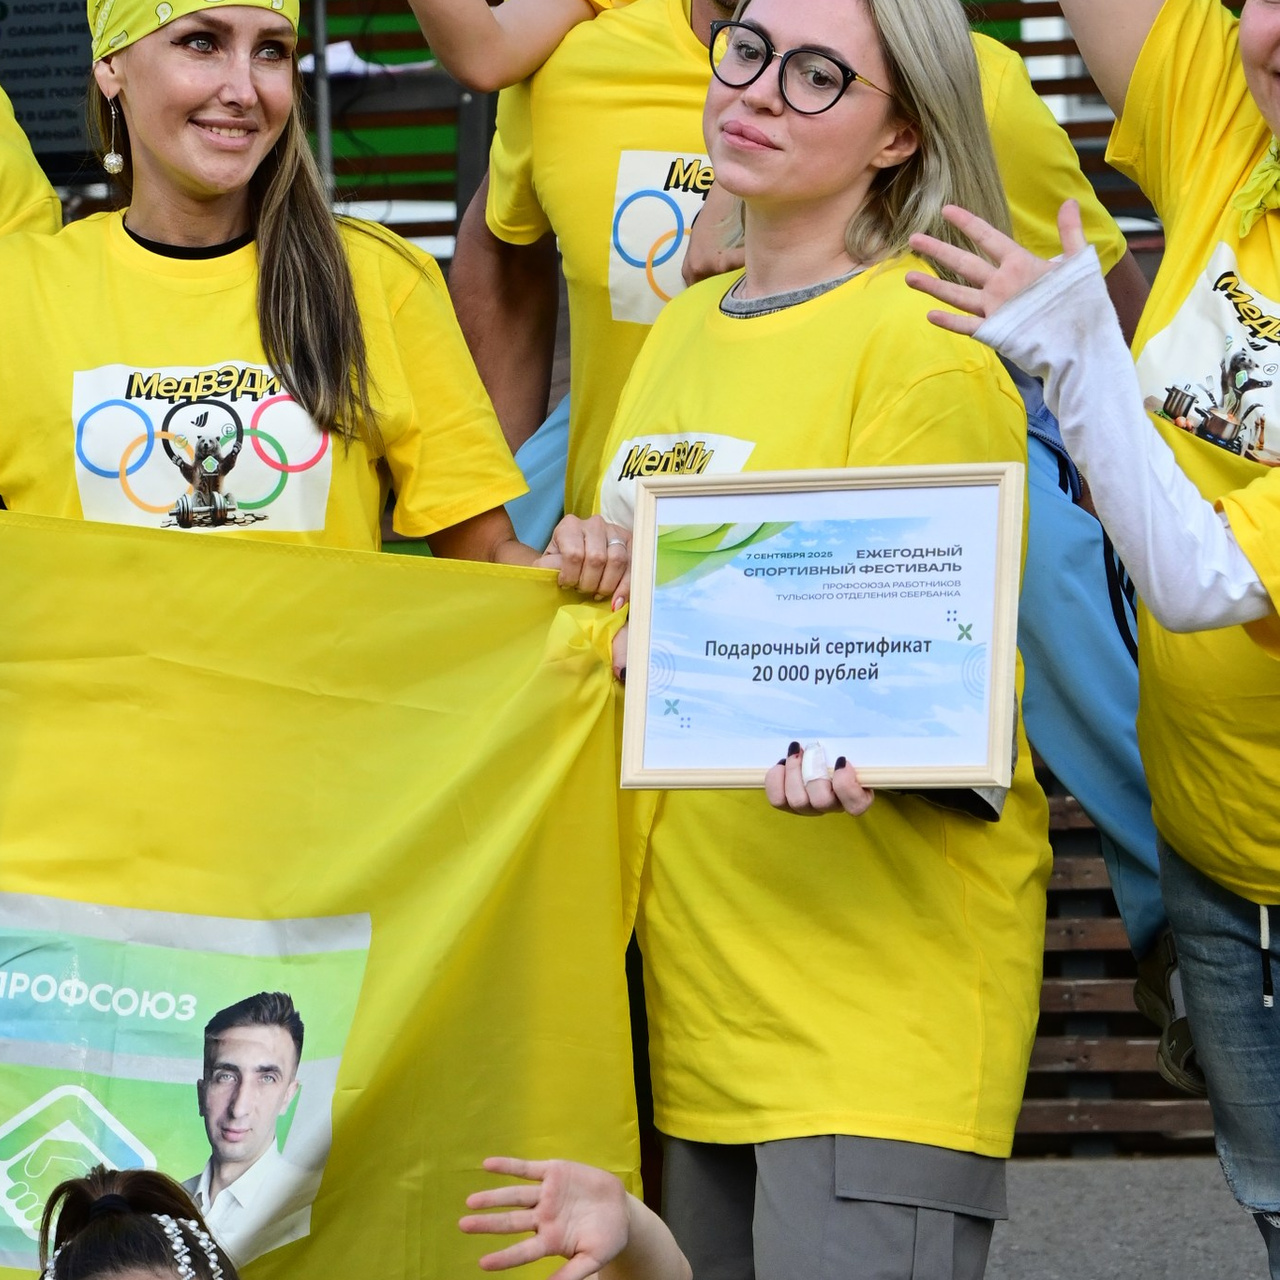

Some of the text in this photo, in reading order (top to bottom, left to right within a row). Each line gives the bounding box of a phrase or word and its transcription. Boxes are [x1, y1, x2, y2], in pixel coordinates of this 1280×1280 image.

[13, 1, 56, 16] МОСТ
[0, 45, 78, 60] ЛАБИРИНТ
[753, 552, 806, 560] СЕНТЯБРЯ
[807, 551, 833, 559] 2025
[856, 544, 963, 559] ЕЖЕГОДНЫЙ
[743, 562, 963, 578] СПОРТИВНЫЙ ФЕСТИВАЛЬ
[822, 580, 962, 591] ПРОФСОЮЗА РАБОТНИКОВ
[776, 590, 962, 601] ТУЛЬСКОГО ОТДЕЛЕНИЯ СБЕРБАНКА
[705, 636, 932, 660] Подарочный сертификат
[752, 662, 879, 685] 20 000 рублей
